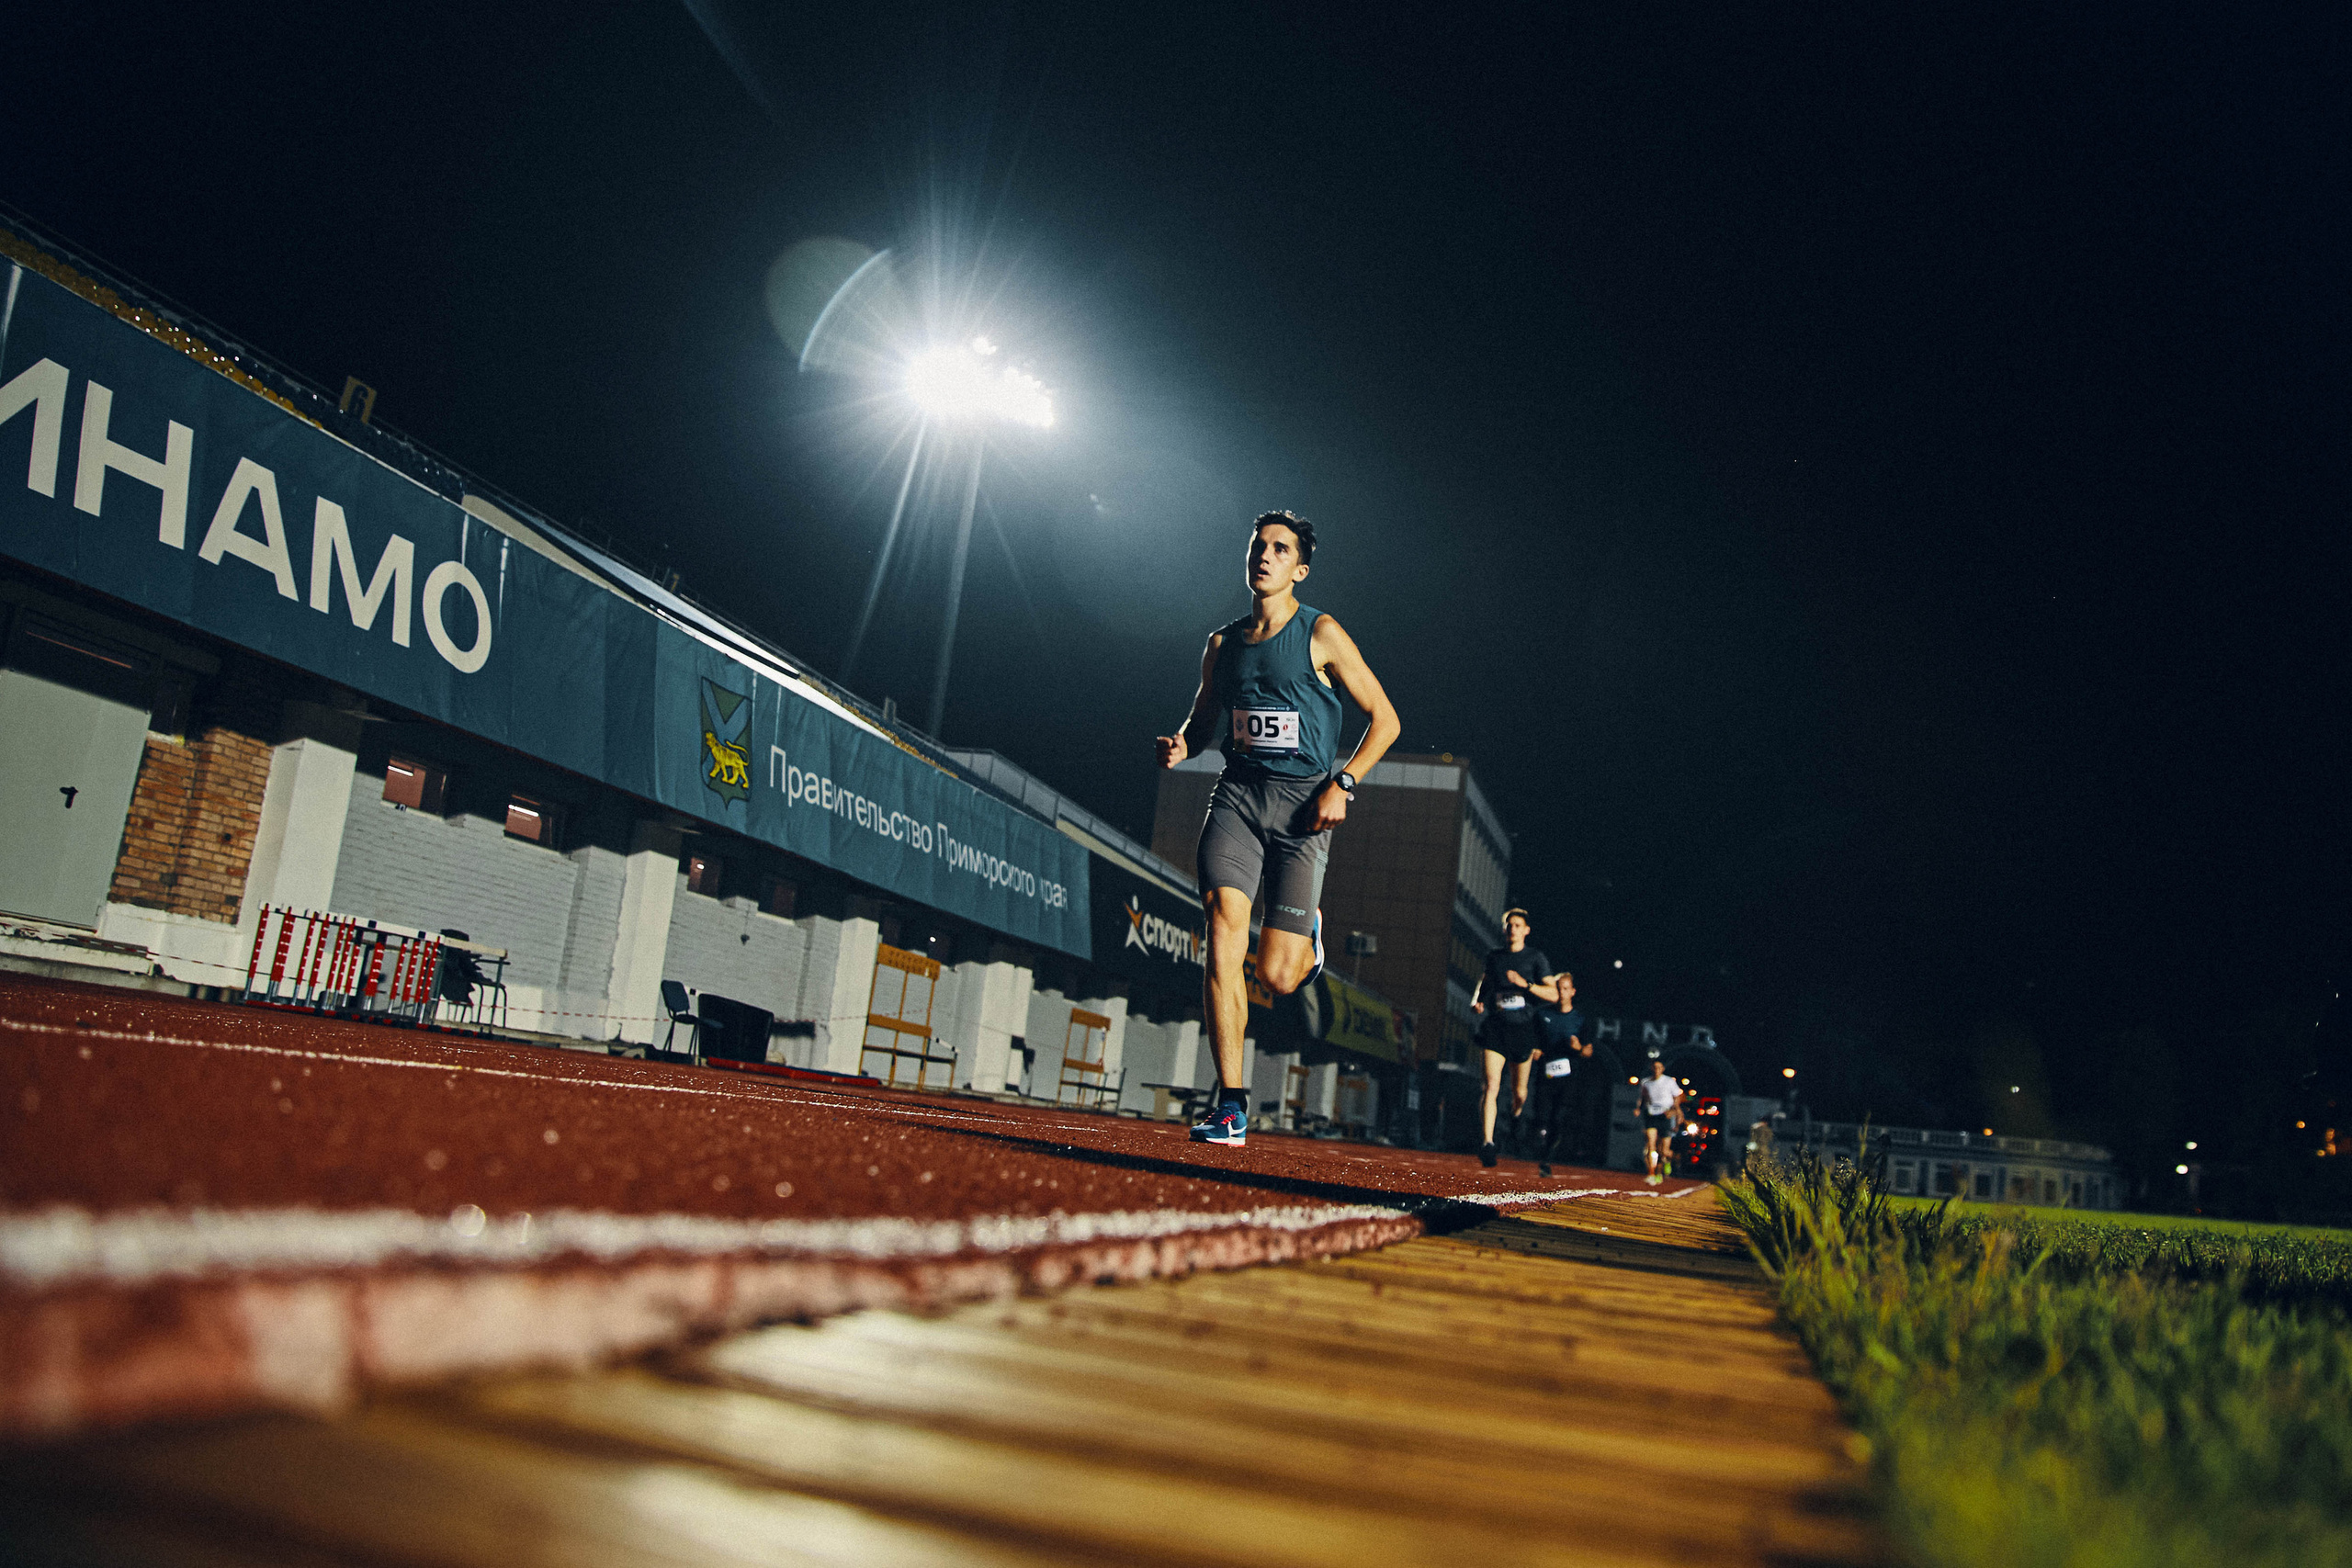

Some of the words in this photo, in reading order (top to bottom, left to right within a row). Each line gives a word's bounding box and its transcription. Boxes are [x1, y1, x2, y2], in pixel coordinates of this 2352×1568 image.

[1248, 715, 1280, 738] 05
[770, 744, 933, 853] Правительство
[937, 822, 1035, 897] Приморского
[1283, 906, 1306, 917] cep
